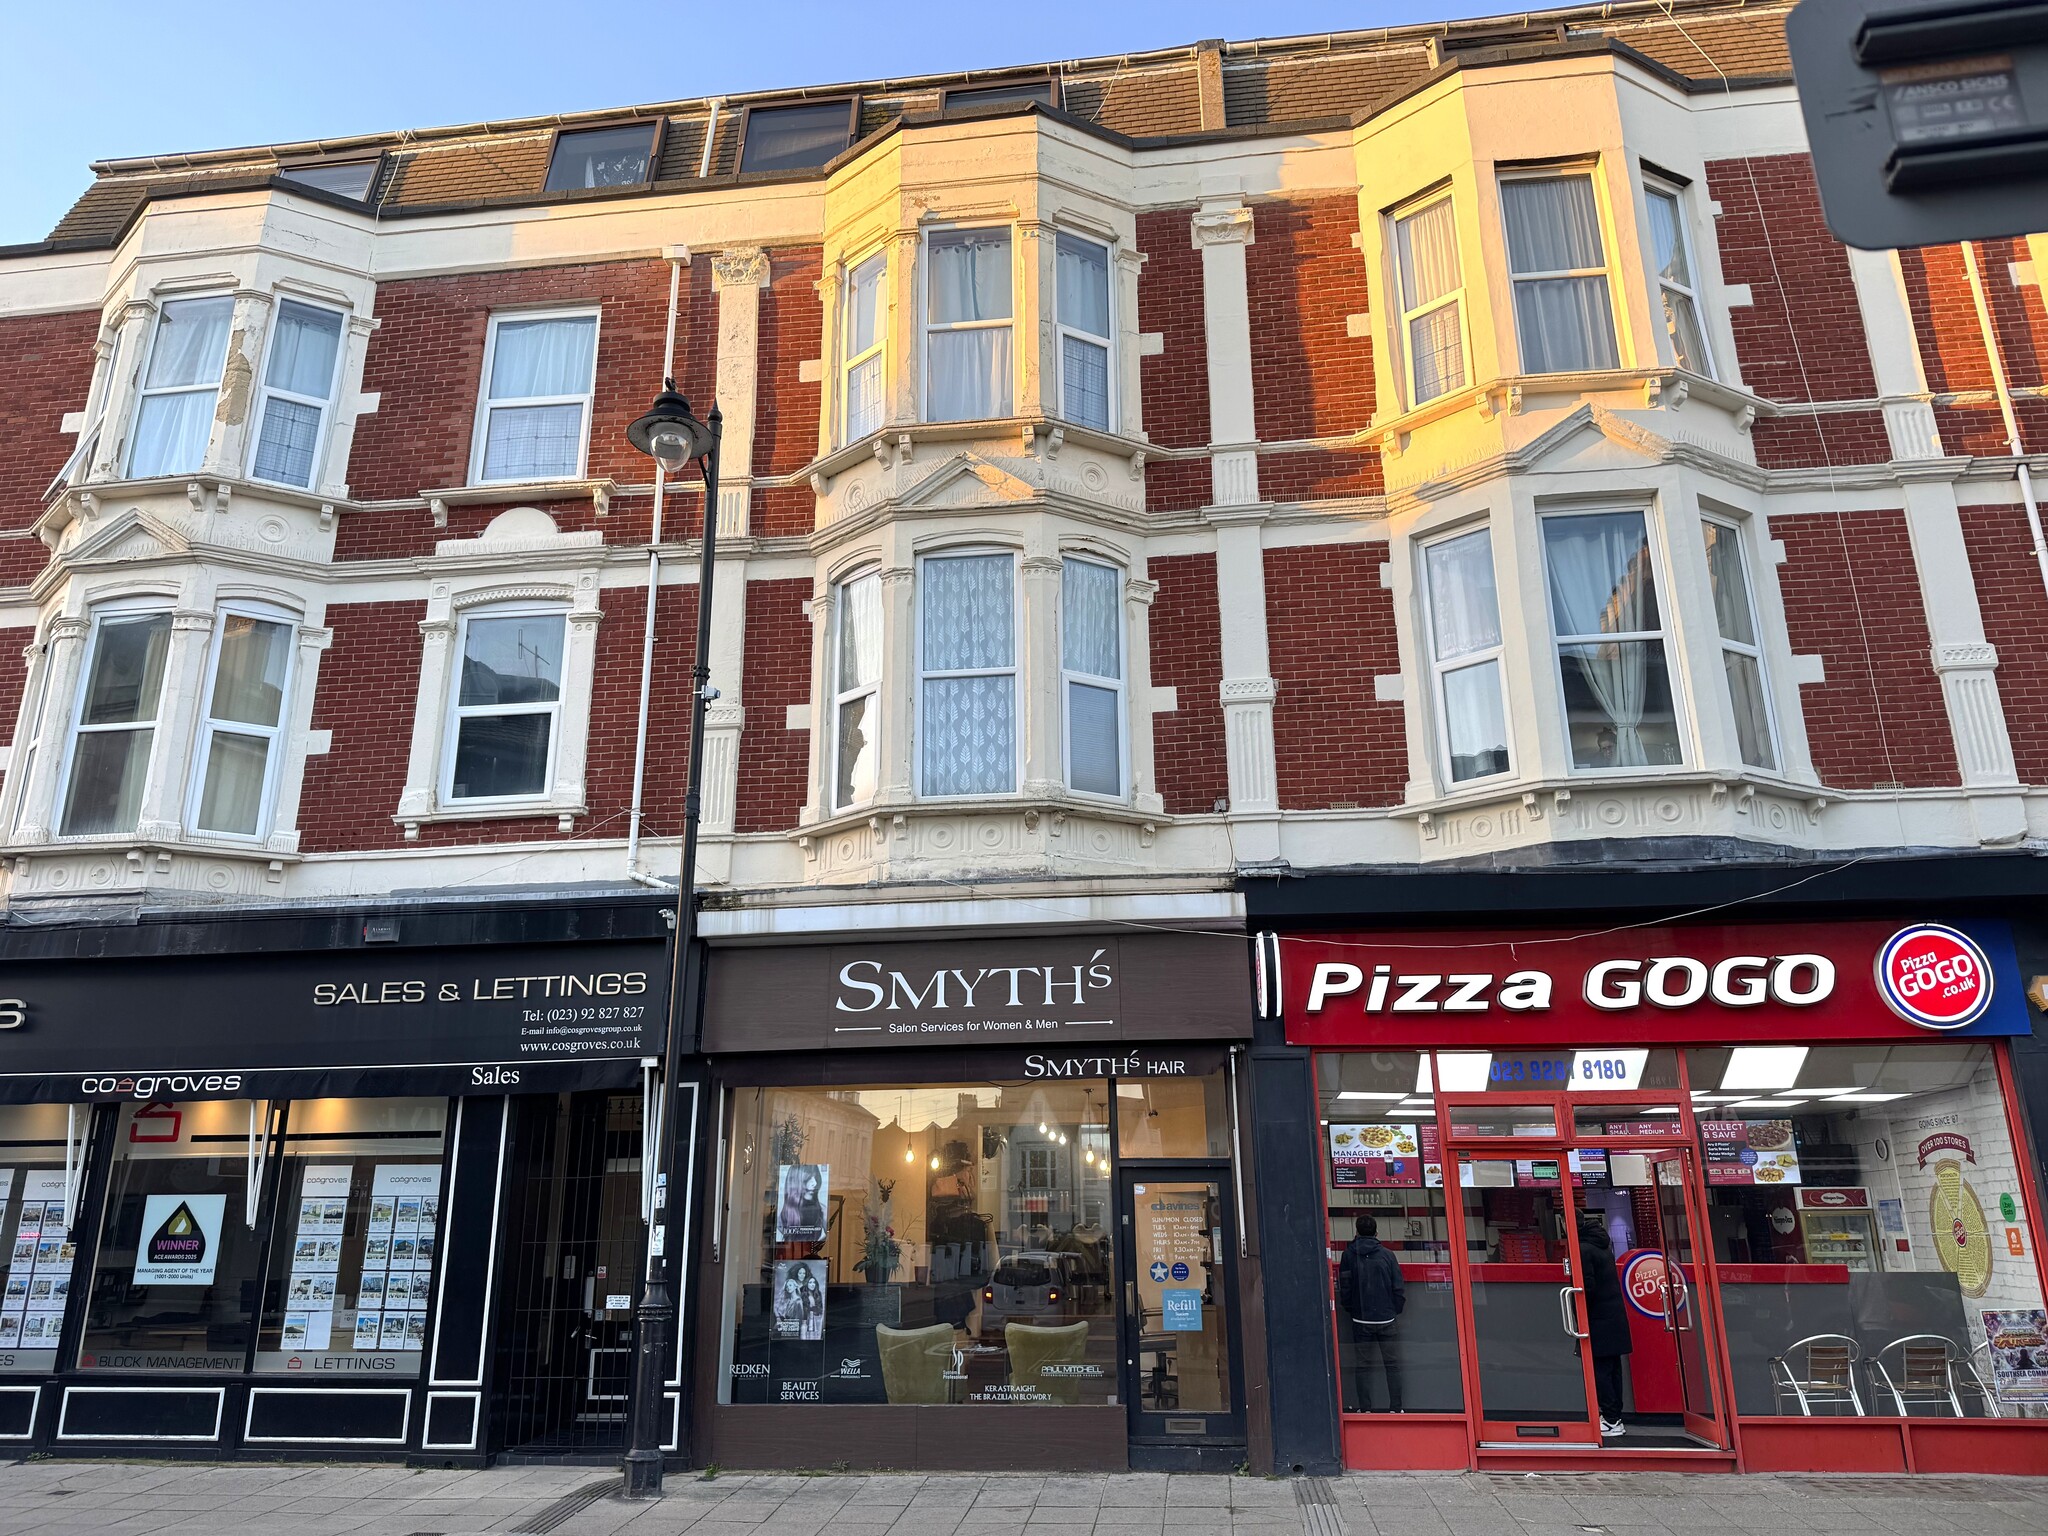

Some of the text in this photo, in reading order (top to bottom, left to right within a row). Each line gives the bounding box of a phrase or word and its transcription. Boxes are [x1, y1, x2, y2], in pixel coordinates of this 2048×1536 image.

[1900, 951, 1938, 973] Pizza
[1899, 954, 1973, 997] GOGO
[313, 971, 648, 1006] SALES & LETTINGS
[1305, 961, 1553, 1013] Pizza
[1583, 953, 1836, 1010] GOGO
[1942, 977, 1976, 998] .co.uk
[522, 1006, 645, 1023] Tel: (023) 92 827 827
[521, 1024, 643, 1037] E-mail info@cosgrovesgroup.co.uk
[888, 1019, 1059, 1034] Salon Services for Women & Men
[520, 1037, 641, 1053] www.cosgroves.co.uk
[1146, 1061, 1186, 1075] HAIR
[1490, 1061, 1524, 1082] 023
[1582, 1059, 1626, 1080] 8180
[471, 1066, 520, 1086] Sales
[1702, 1123, 1743, 1131] COLLECT
[1919, 1119, 1935, 1129] GOING
[1934, 1115, 1951, 1126] SINCE
[1712, 1131, 1737, 1139] SAVE
[1921, 1139, 1935, 1153] OVER
[1943, 1136, 1967, 1149] STORES
[156, 1239, 200, 1250] WINNER
[1634, 1269, 1658, 1281] Pizza
[1167, 1299, 1197, 1311] Refill
[98, 1355, 241, 1370] BLOCK MANAGEMENT
[314, 1357, 396, 1370] LETTINGS
[729, 1364, 771, 1375] REDKEN
[1041, 1365, 1102, 1374] PAUL MITCHELL
[1997, 1370, 2027, 1378] SOUTHSEA
[782, 1381, 818, 1391] BEAUTY
[780, 1391, 820, 1401] SERVICES
[1020, 1393, 1052, 1401] BLOWDRY
